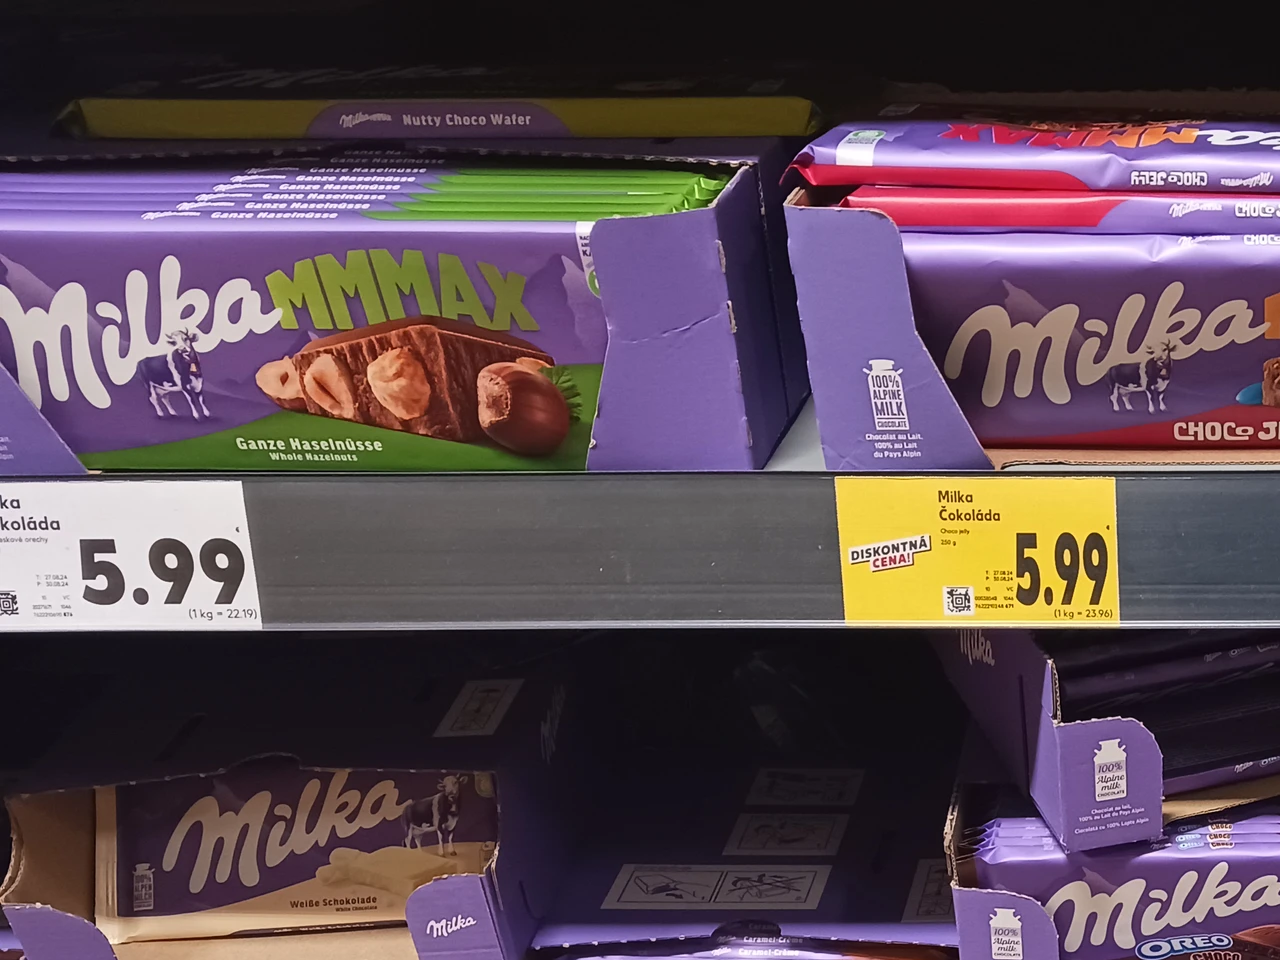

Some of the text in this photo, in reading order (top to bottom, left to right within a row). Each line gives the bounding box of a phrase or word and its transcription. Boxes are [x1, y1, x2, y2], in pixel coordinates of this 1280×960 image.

[403, 113, 532, 127] Nutty Choco Wafer
[1235, 202, 1274, 218] CHOCO
[0, 249, 540, 409] Milka MMMAX
[943, 281, 1272, 407] Milka
[871, 375, 900, 388] 100%
[873, 390, 902, 400] ALPINE
[874, 401, 905, 416] MILK
[1173, 421, 1253, 441] CHOCO
[235, 437, 384, 453] Ganze Haselnüsse
[268, 452, 359, 463] Whole Hazelnuts
[938, 490, 973, 503] Milka
[939, 506, 1001, 521] Čokoláda
[851, 536, 928, 561] DISKONTNÁ
[872, 553, 911, 568] CENA!
[79, 538, 245, 605] 5.99
[1015, 532, 1108, 606] 5.99
[162, 770, 412, 894] Milka
[290, 895, 378, 908] Weiße Schokolade
[426, 915, 477, 938] Milka
[1139, 934, 1231, 958] OREO
